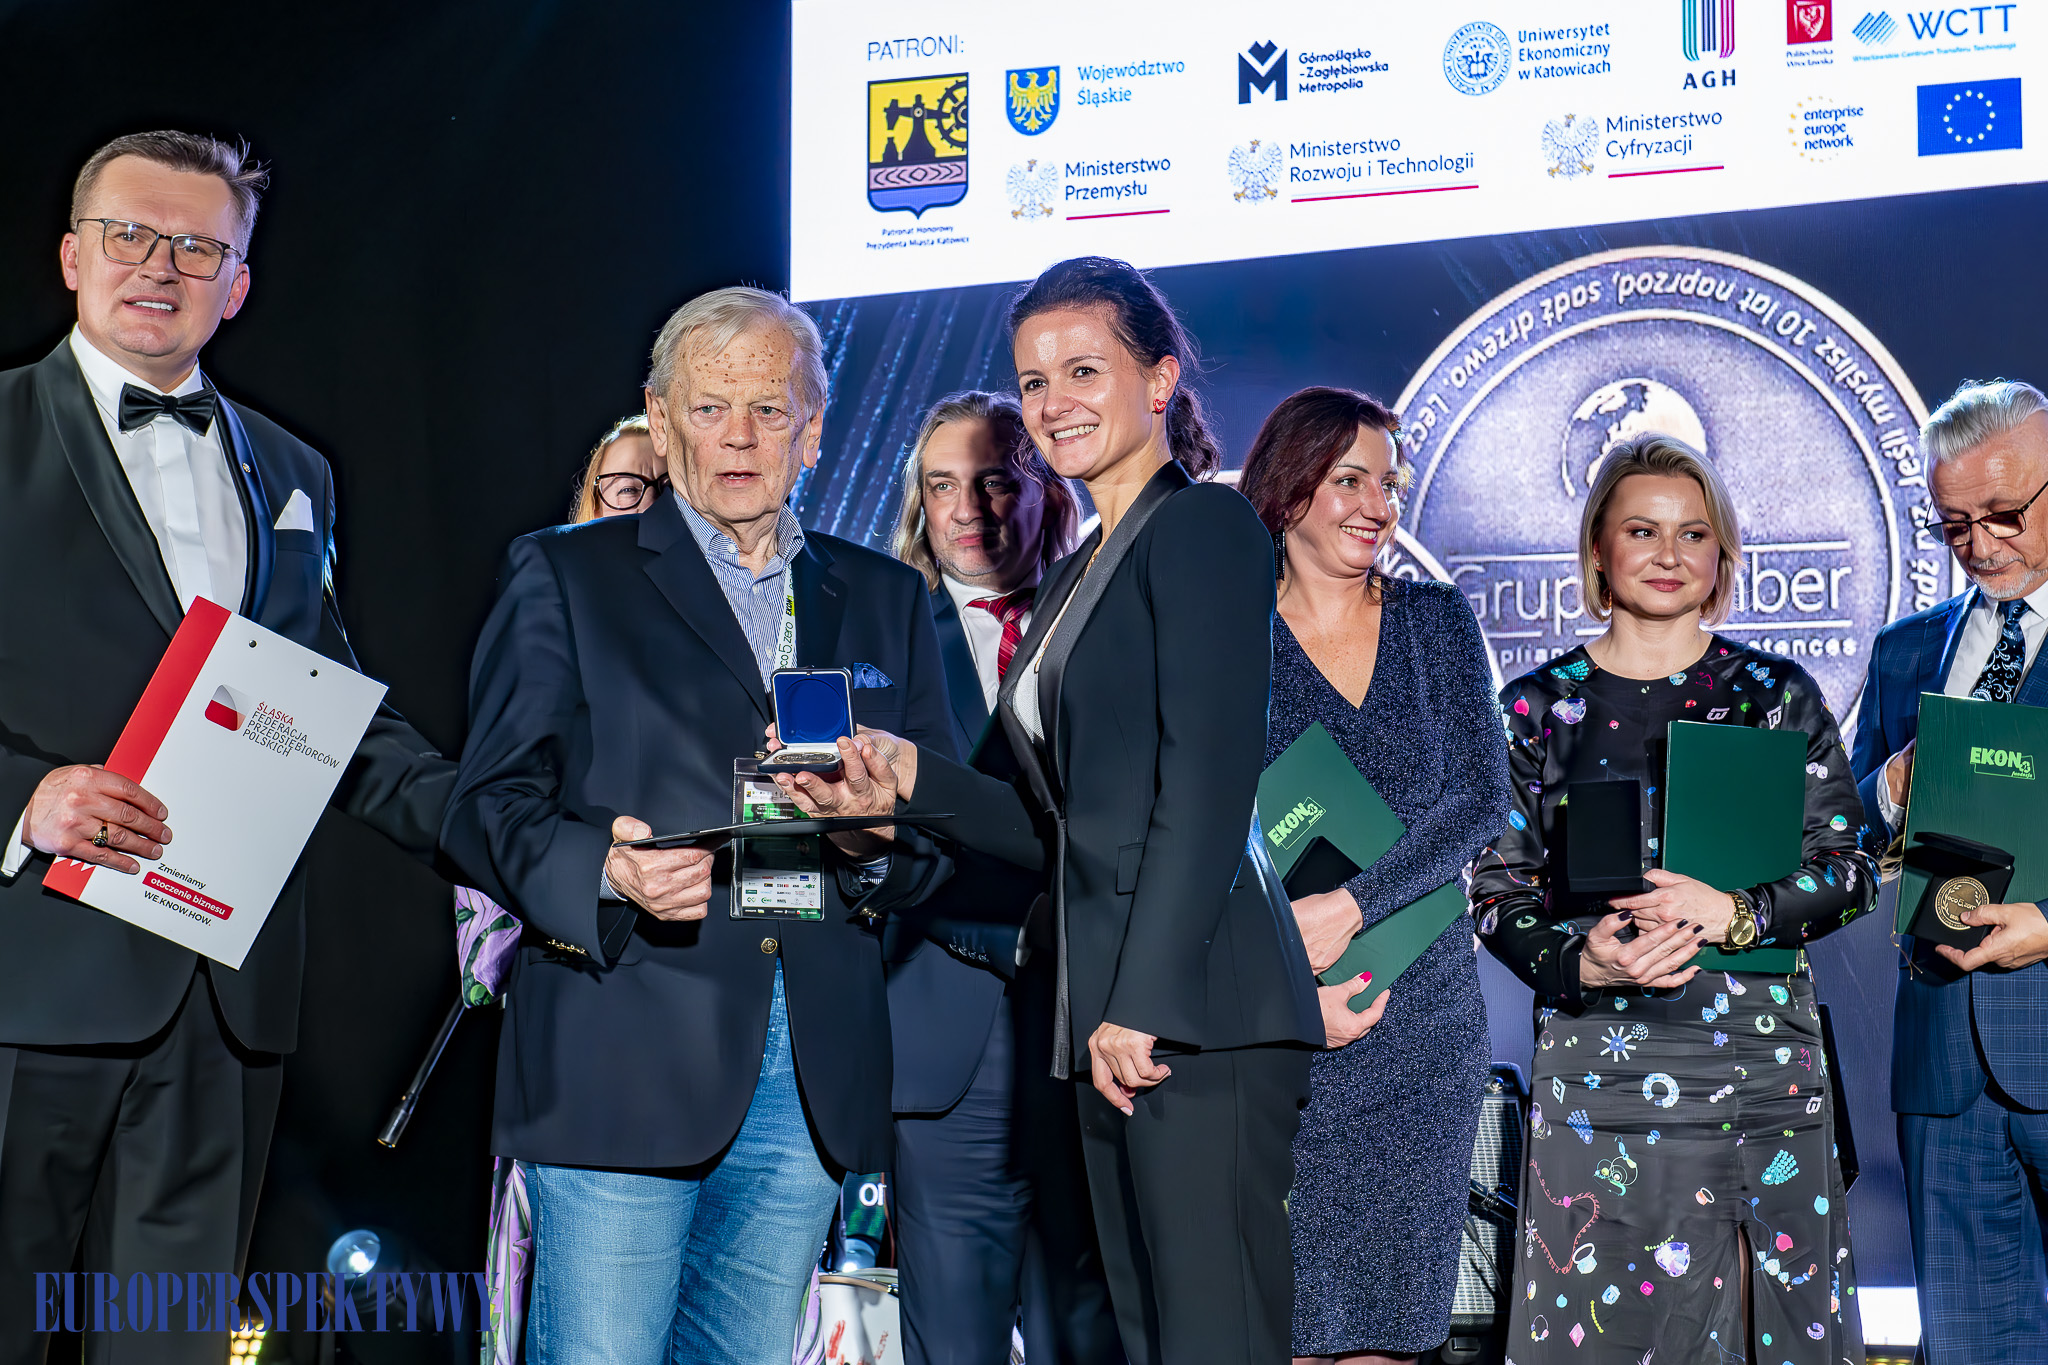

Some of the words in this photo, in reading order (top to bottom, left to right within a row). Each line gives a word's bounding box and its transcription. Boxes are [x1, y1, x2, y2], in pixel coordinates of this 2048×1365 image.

[1518, 23, 1611, 43] Uniwersytet
[1907, 4, 2017, 40] WCTT
[867, 34, 965, 61] PATRONI:
[1519, 43, 1611, 62] Ekonomiczny
[1077, 60, 1185, 83] Województwo
[1518, 69, 1531, 81] w
[1534, 60, 1611, 79] Katowicach
[1682, 69, 1736, 90] AGH
[1077, 86, 1132, 108] Śląskie
[1298, 78, 1364, 93] Metropolia
[1606, 112, 1723, 134] Ministerstwo
[1803, 105, 1864, 122] enterprise
[1804, 123, 1847, 137] europe
[1290, 138, 1401, 159] Ministerstwo
[1605, 134, 1692, 160] Cyfryzacji
[1804, 134, 1854, 150] network
[1065, 158, 1171, 178] Ministerstwo
[1290, 161, 1362, 183] Rozwoju
[1367, 160, 1372, 177] i
[1377, 152, 1474, 174] Technologii
[1065, 180, 1147, 201] Przemysłu
[1737, 288, 1780, 326] lat
[1776, 310, 1817, 346] 10
[1405, 393, 1451, 455] Lecz
[256, 701, 294, 726] ŚLĄSKA
[251, 710, 308, 744] FEDERACJA
[242, 728, 293, 757] POLSKICH
[1969, 746, 2022, 769] EKON
[1267, 802, 1311, 848] EKON
[158, 862, 207, 890] Zmieniamy
[150, 878, 192, 901] otoczenie
[192, 894, 226, 916] biznesu
